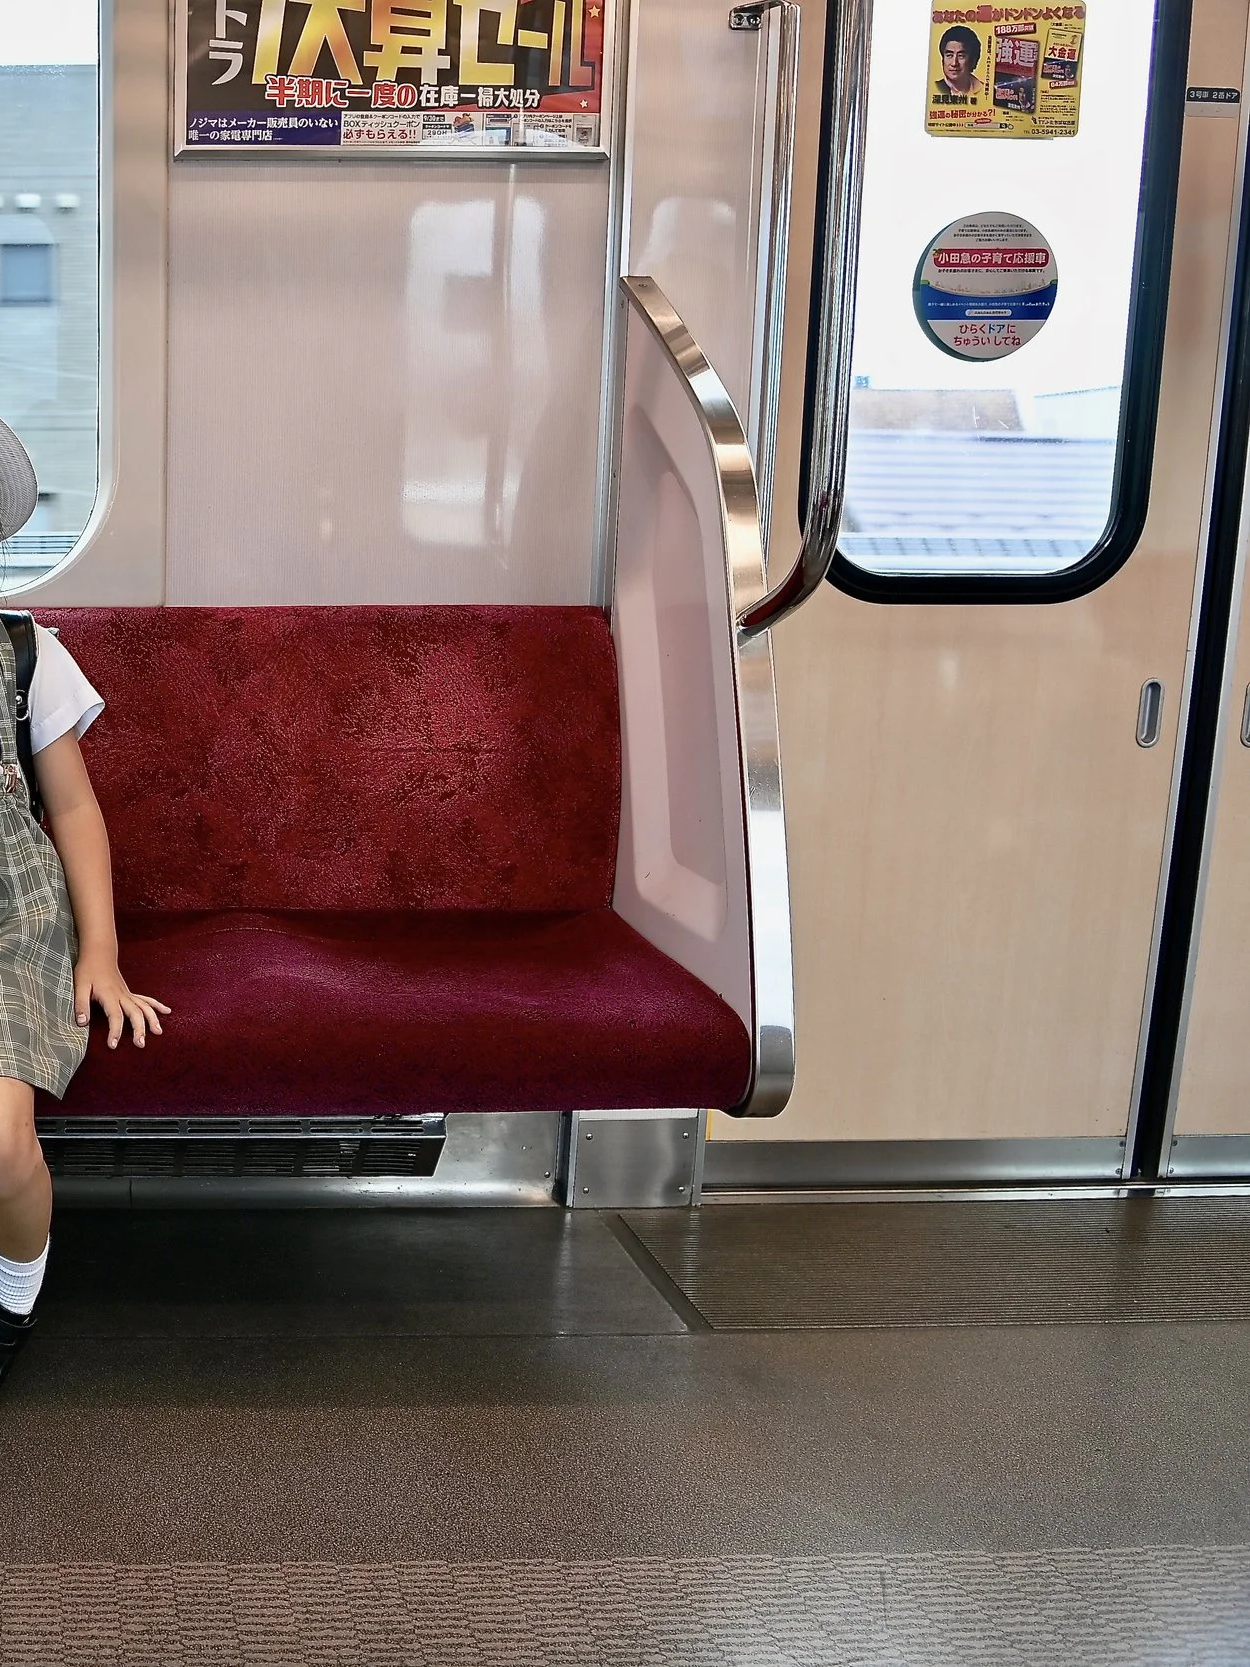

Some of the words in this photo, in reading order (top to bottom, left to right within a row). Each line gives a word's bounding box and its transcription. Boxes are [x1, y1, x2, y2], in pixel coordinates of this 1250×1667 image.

[189, 116, 339, 129] ノジマはメーカー販売員のいない
[188, 130, 273, 141] 唯一の家電専門店
[938, 252, 1046, 264] 小田急の子育て応援車
[959, 323, 1016, 334] ひらくドアに
[953, 335, 1021, 346] ちゅういしてね
